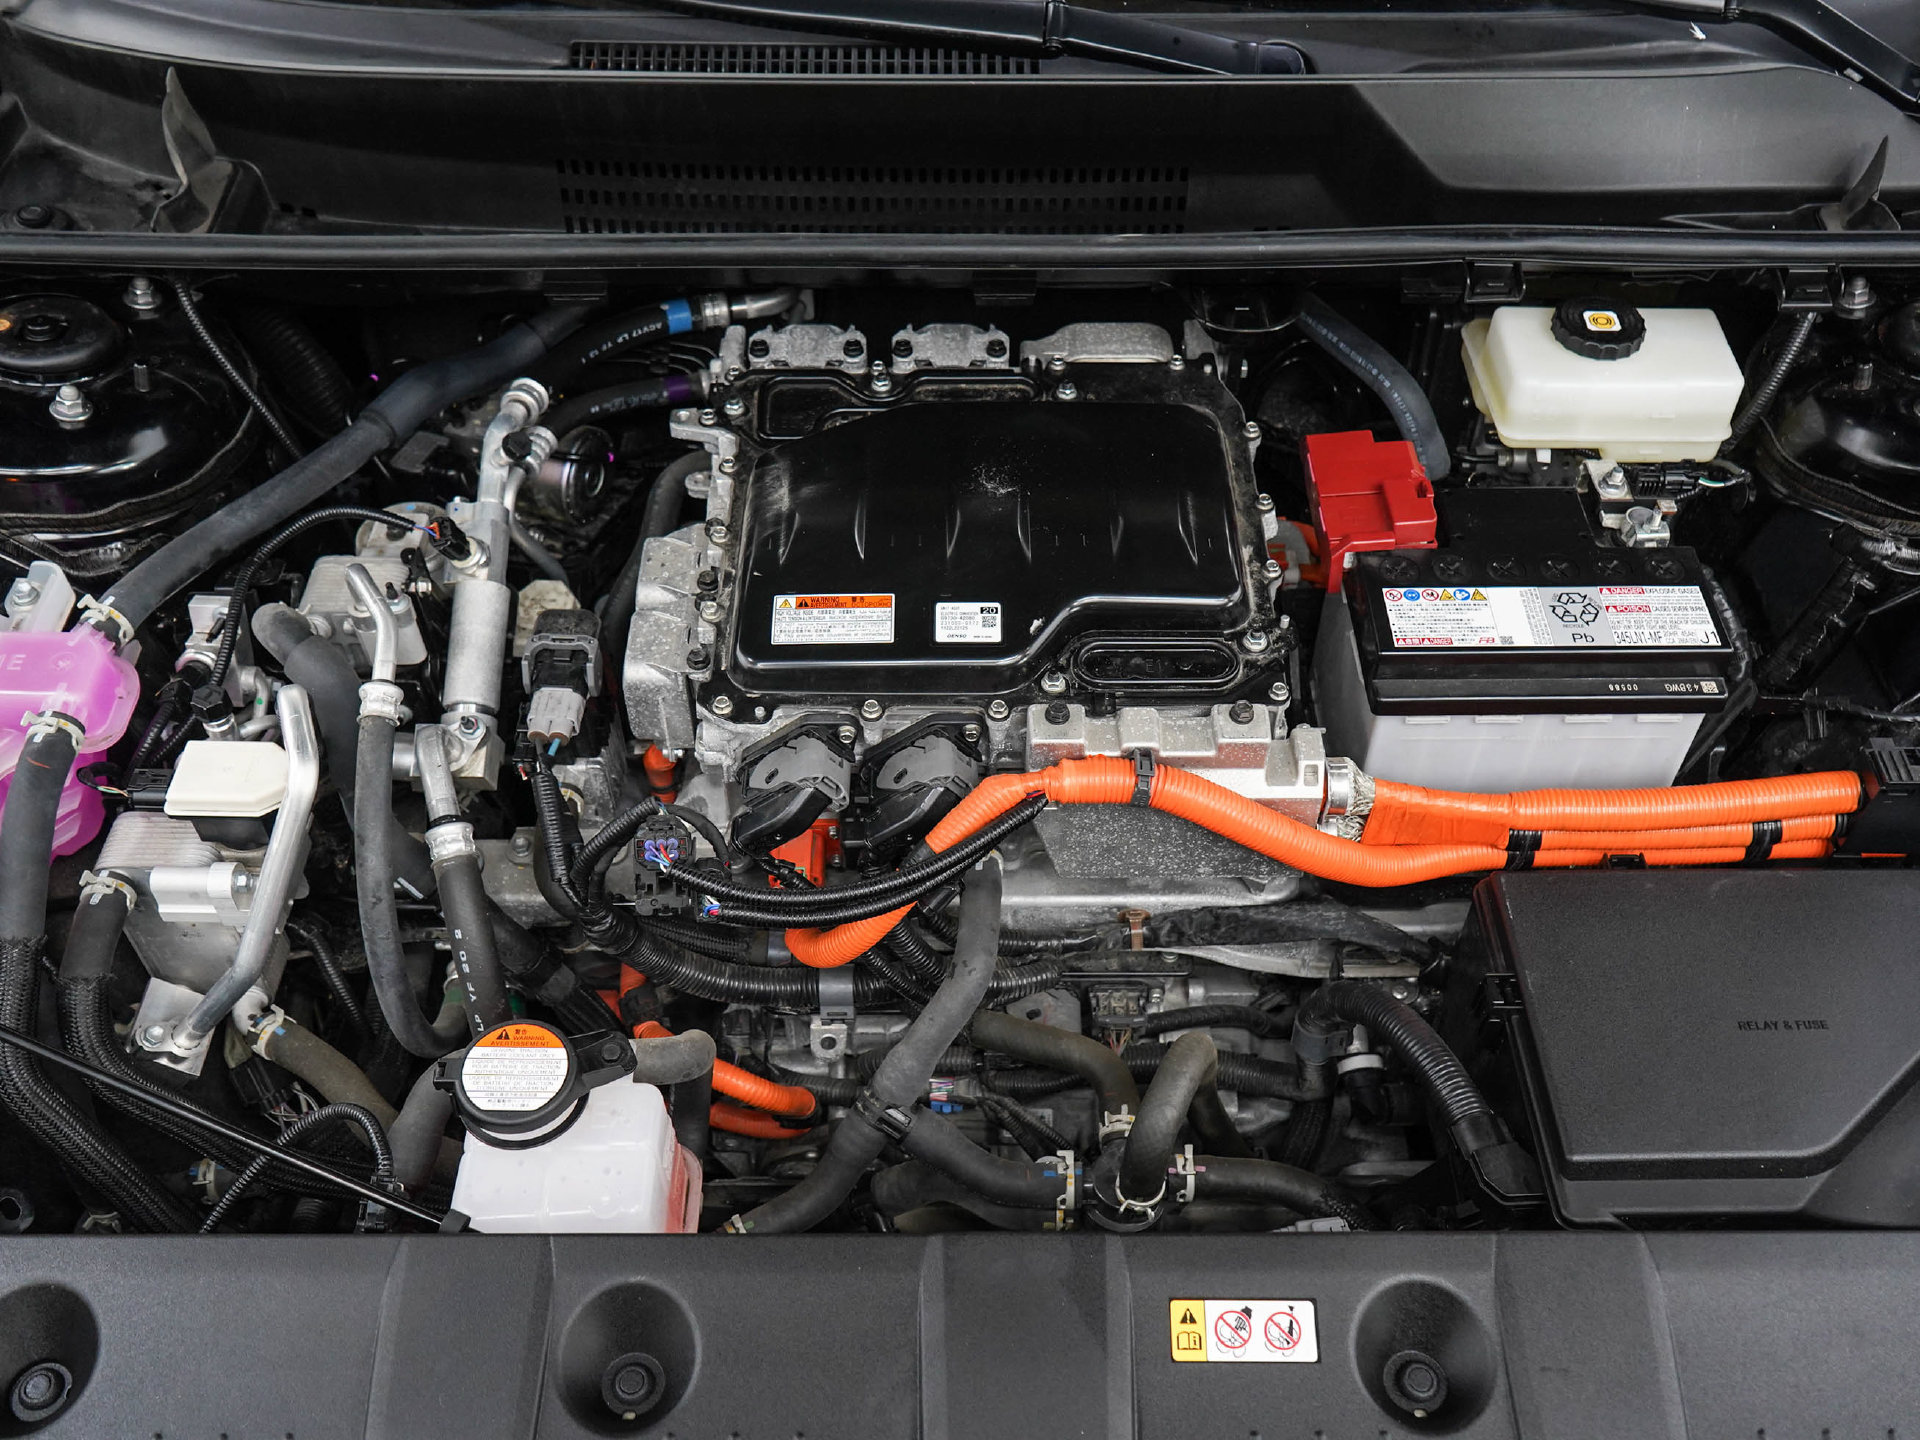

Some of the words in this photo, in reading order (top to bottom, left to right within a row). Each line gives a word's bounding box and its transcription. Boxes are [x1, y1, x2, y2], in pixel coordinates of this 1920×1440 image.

[1572, 633, 1595, 643] Pb
[459, 950, 470, 973] 20
[466, 982, 477, 1002] YF
[474, 1014, 484, 1032] LP
[1737, 1020, 1778, 1031] RELAY
[1783, 1020, 1793, 1030] &
[1794, 1020, 1829, 1030] FUSE
